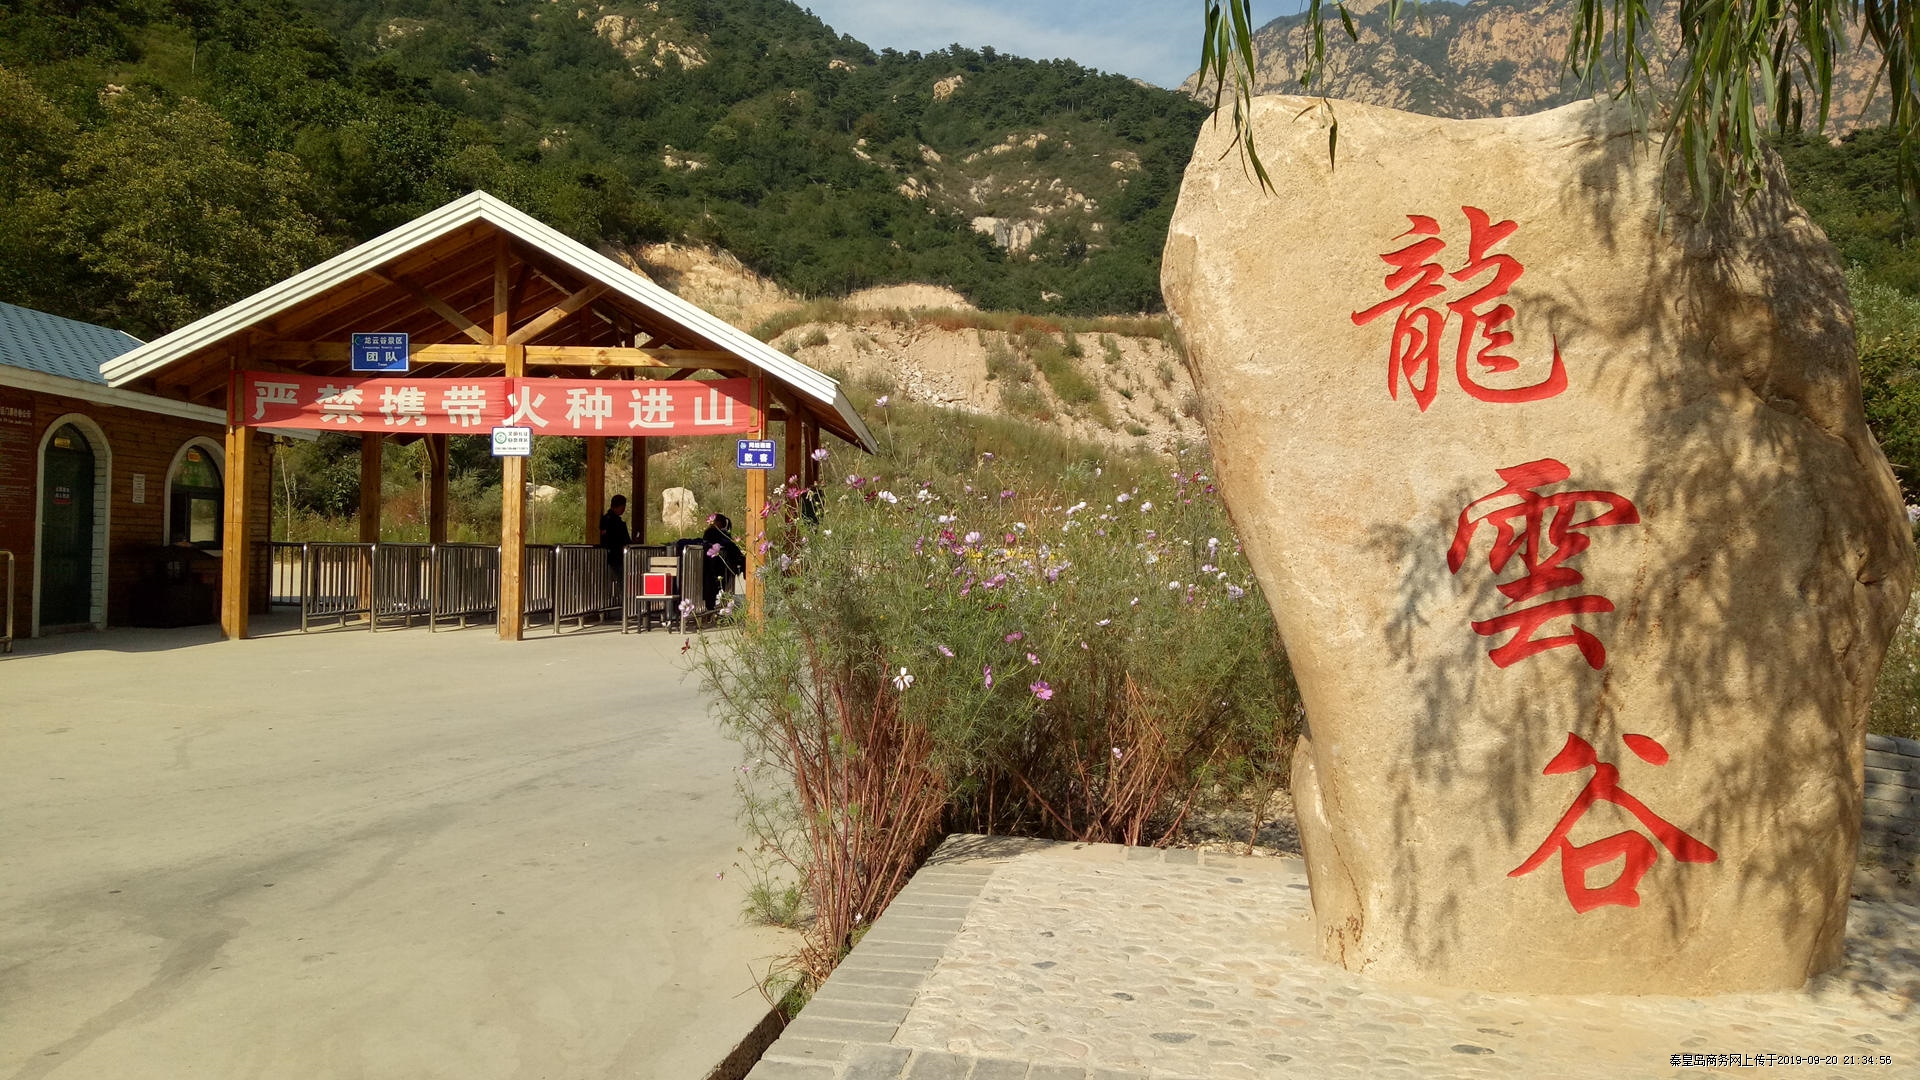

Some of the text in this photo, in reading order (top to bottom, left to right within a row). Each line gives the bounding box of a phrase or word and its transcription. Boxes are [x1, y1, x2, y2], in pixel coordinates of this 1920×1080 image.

[366, 351, 398, 362] 团队
[252, 381, 735, 428] 严禁携带火种进山
[1351, 206, 1718, 914] 龍雲谷
